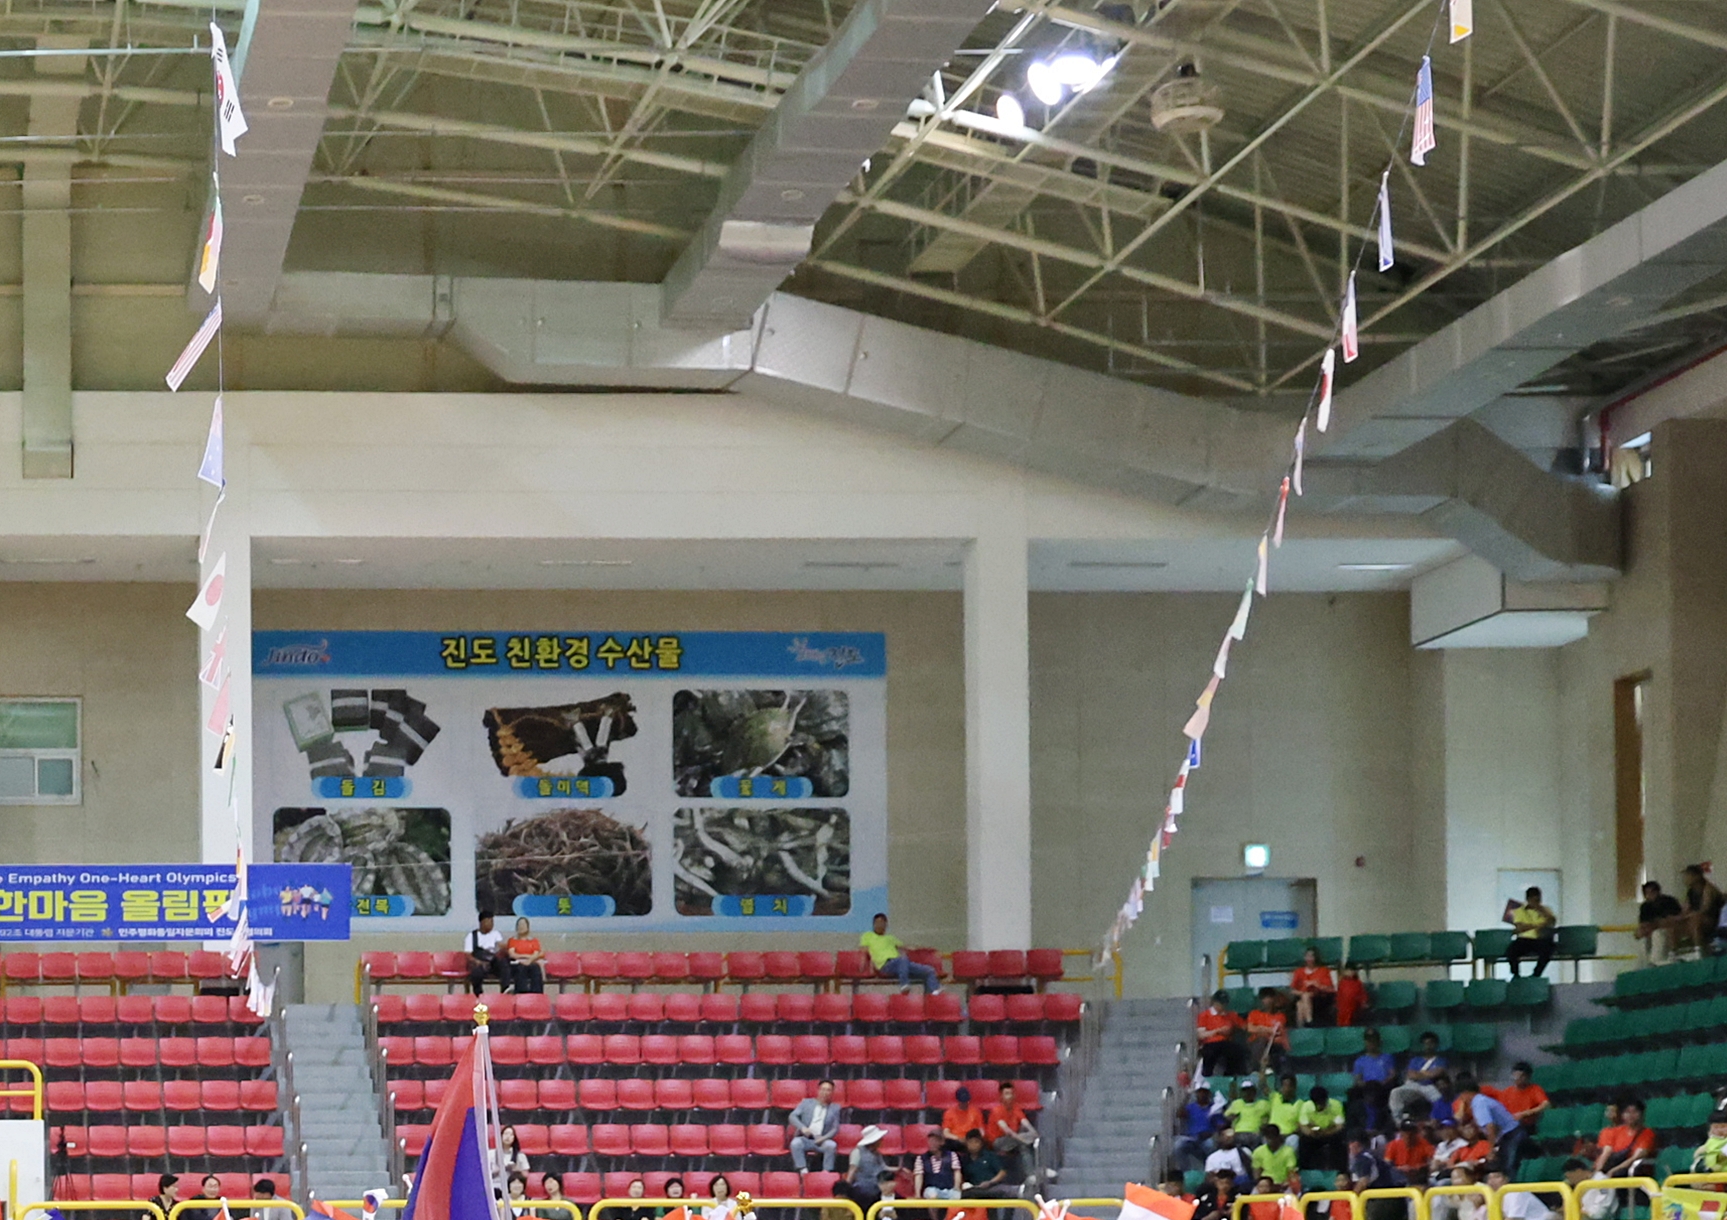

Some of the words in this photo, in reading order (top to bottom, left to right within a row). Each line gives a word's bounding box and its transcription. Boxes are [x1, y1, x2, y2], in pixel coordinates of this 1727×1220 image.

[440, 636, 498, 670] 진도
[506, 636, 589, 671] 친환경
[596, 636, 683, 670] 수산물
[8, 873, 74, 887] Empathy
[80, 872, 161, 884] One-Heart
[166, 872, 237, 886] Olympics
